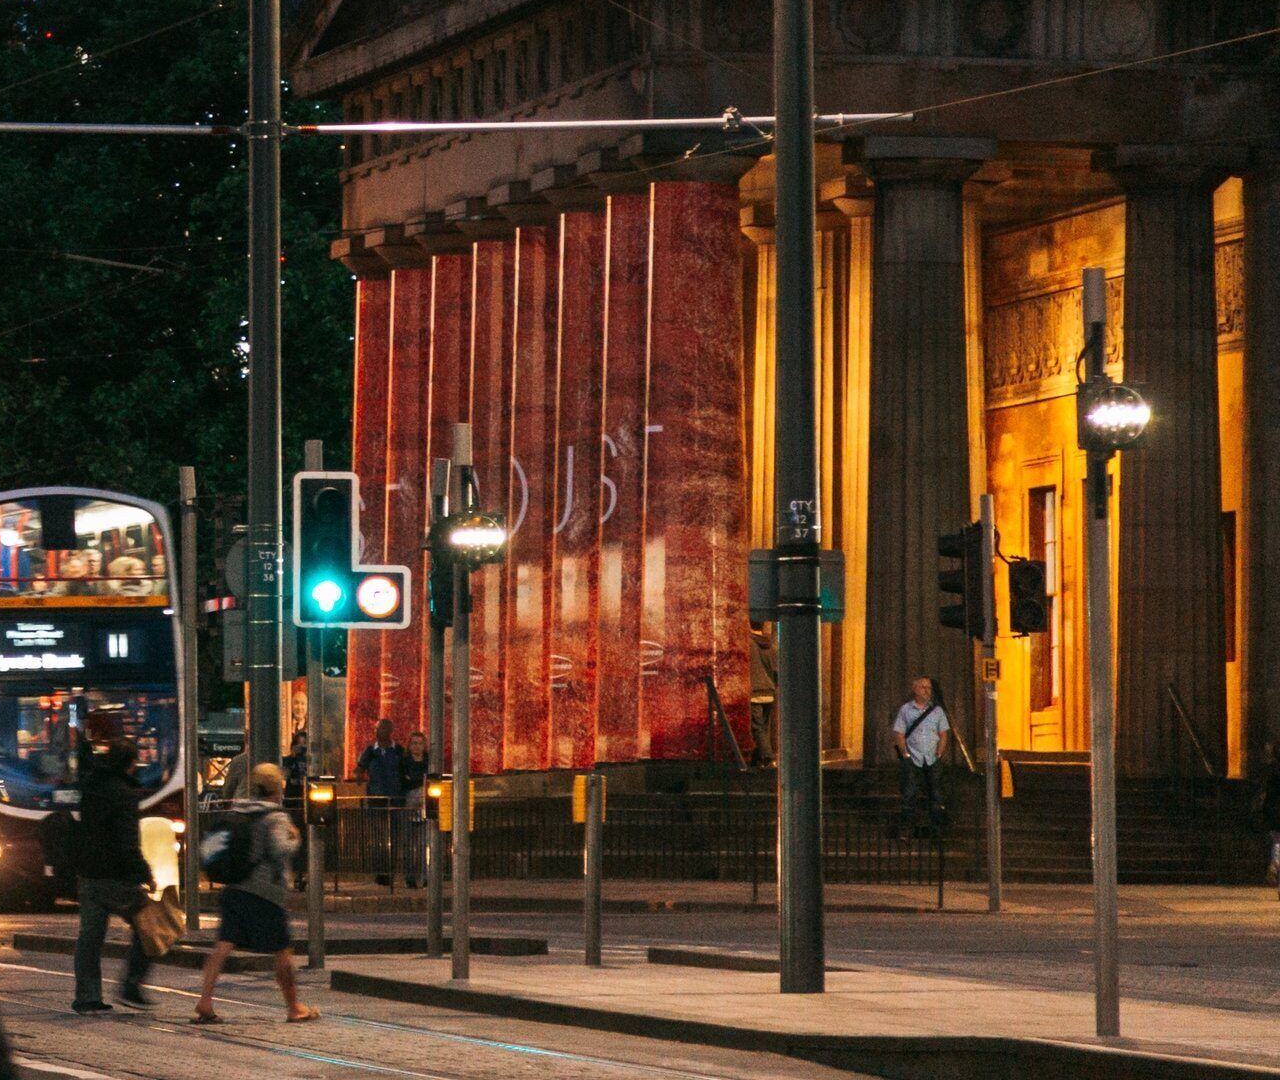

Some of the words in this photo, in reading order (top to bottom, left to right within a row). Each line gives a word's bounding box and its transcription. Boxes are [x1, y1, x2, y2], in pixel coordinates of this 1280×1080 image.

[790, 500, 812, 511] CTY
[794, 528, 809, 538] 37
[258, 551, 277, 560] CTY
[263, 562, 273, 571] 12
